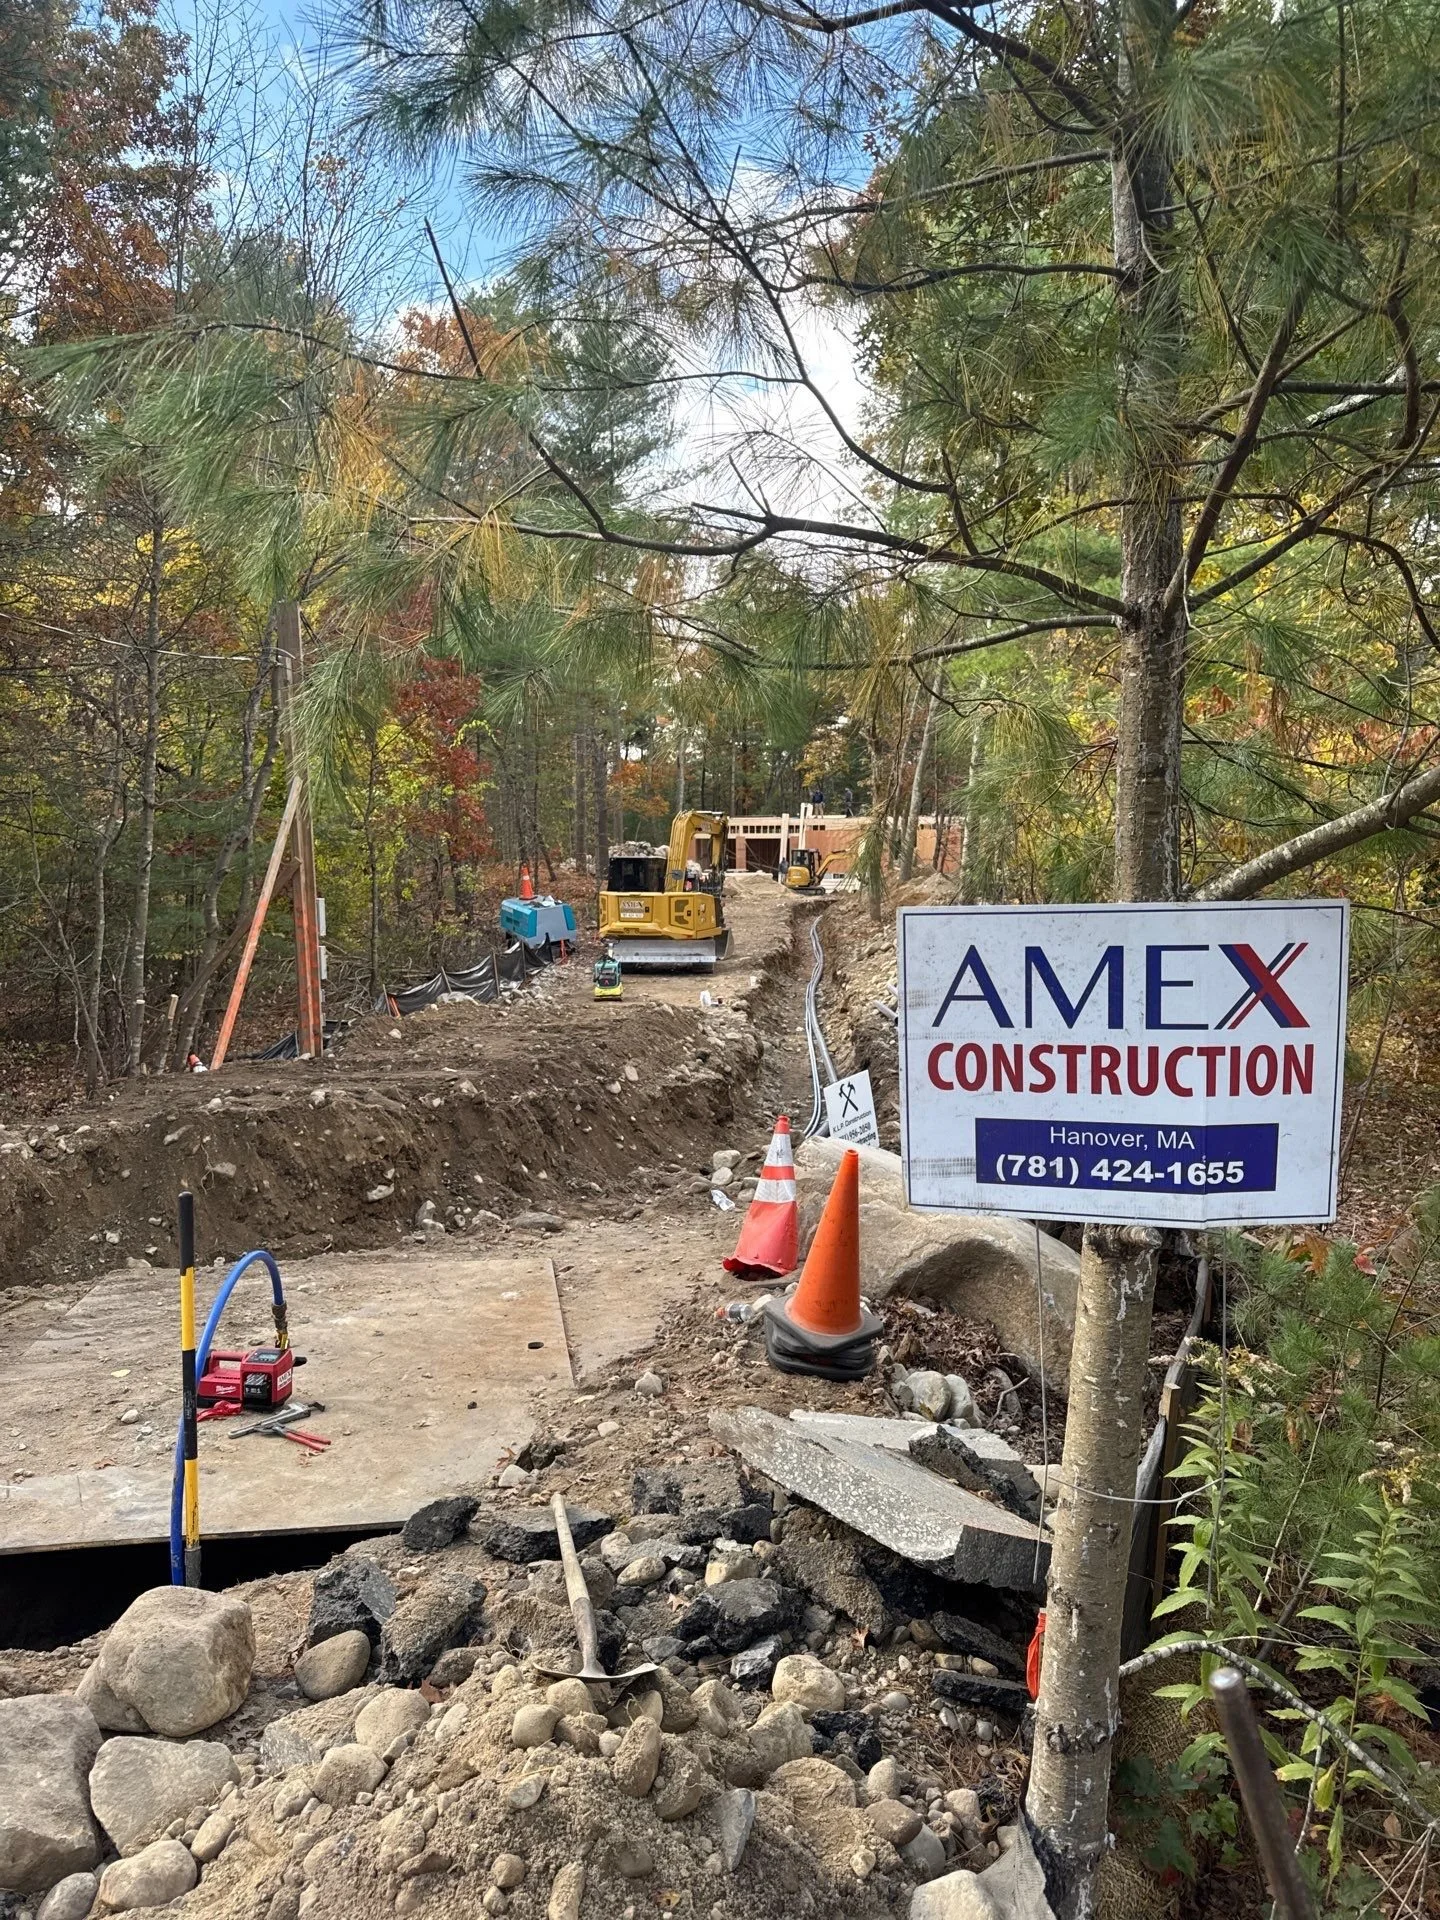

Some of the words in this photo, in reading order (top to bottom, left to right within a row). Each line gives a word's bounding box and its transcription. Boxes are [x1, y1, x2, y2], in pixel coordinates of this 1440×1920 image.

[931, 942, 1311, 1030] AMEX
[927, 1042, 1315, 1098] CONSTRUCTION
[845, 1110, 871, 1127] Construction
[1049, 1126, 1149, 1151] Hanover,
[1157, 1130, 1196, 1150] MA
[995, 1154, 1080, 1185] (781)
[1090, 1158, 1245, 1185] 424-1655
